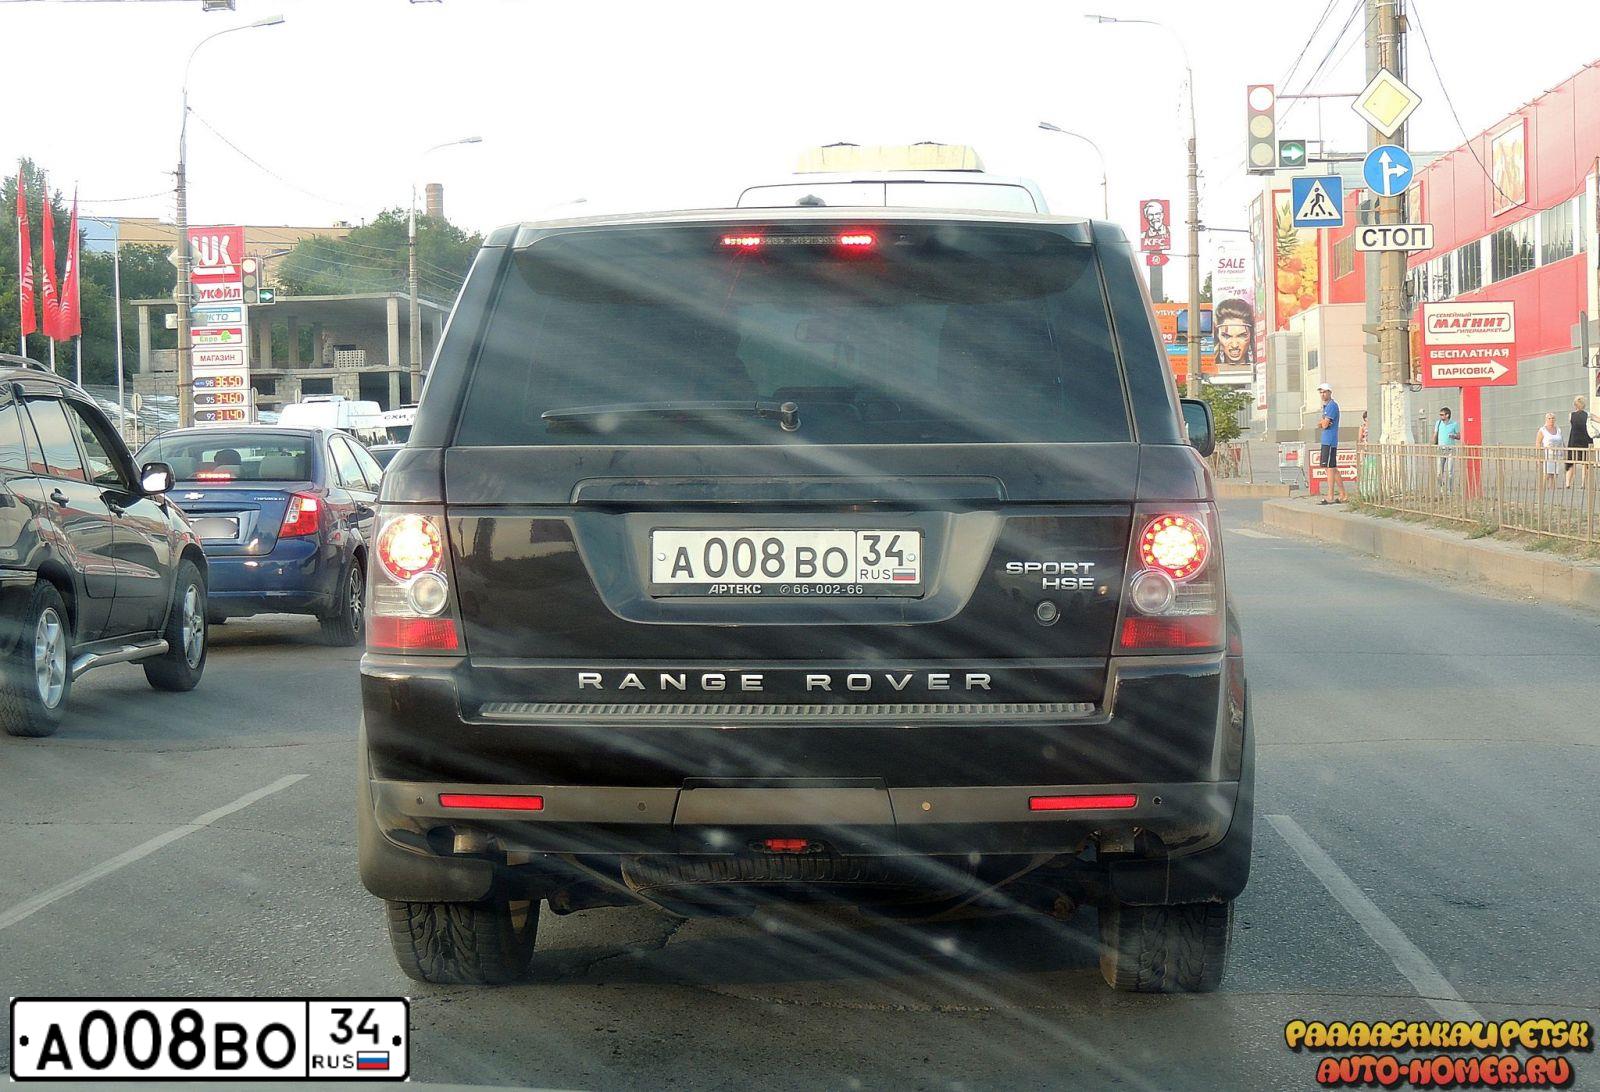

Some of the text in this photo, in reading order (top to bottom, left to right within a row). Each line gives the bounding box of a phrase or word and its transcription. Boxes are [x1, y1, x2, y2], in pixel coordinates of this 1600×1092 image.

[1144, 238, 1166, 246] KFC
[1362, 228, 1426, 247] СТОП
[1217, 258, 1246, 269] SALE
[199, 286, 241, 300] УКОЙЛ
[1433, 317, 1505, 329] МАГНИТ
[200, 354, 236, 362] МАГАЗИН
[1430, 348, 1510, 359] БЕСПЛАТНАЯ
[1437, 367, 1495, 376] ПАРКОВКА
[206, 396, 215, 404] 95
[206, 412, 216, 421] 92
[862, 534, 904, 567] 34
[1005, 561, 1095, 575] SPORT
[860, 569, 891, 580] RUS
[1042, 577, 1095, 590] HSE
[708, 584, 864, 595] АРТЕКС 66-002-66
[577, 672, 992, 691] RANGE ROVER
